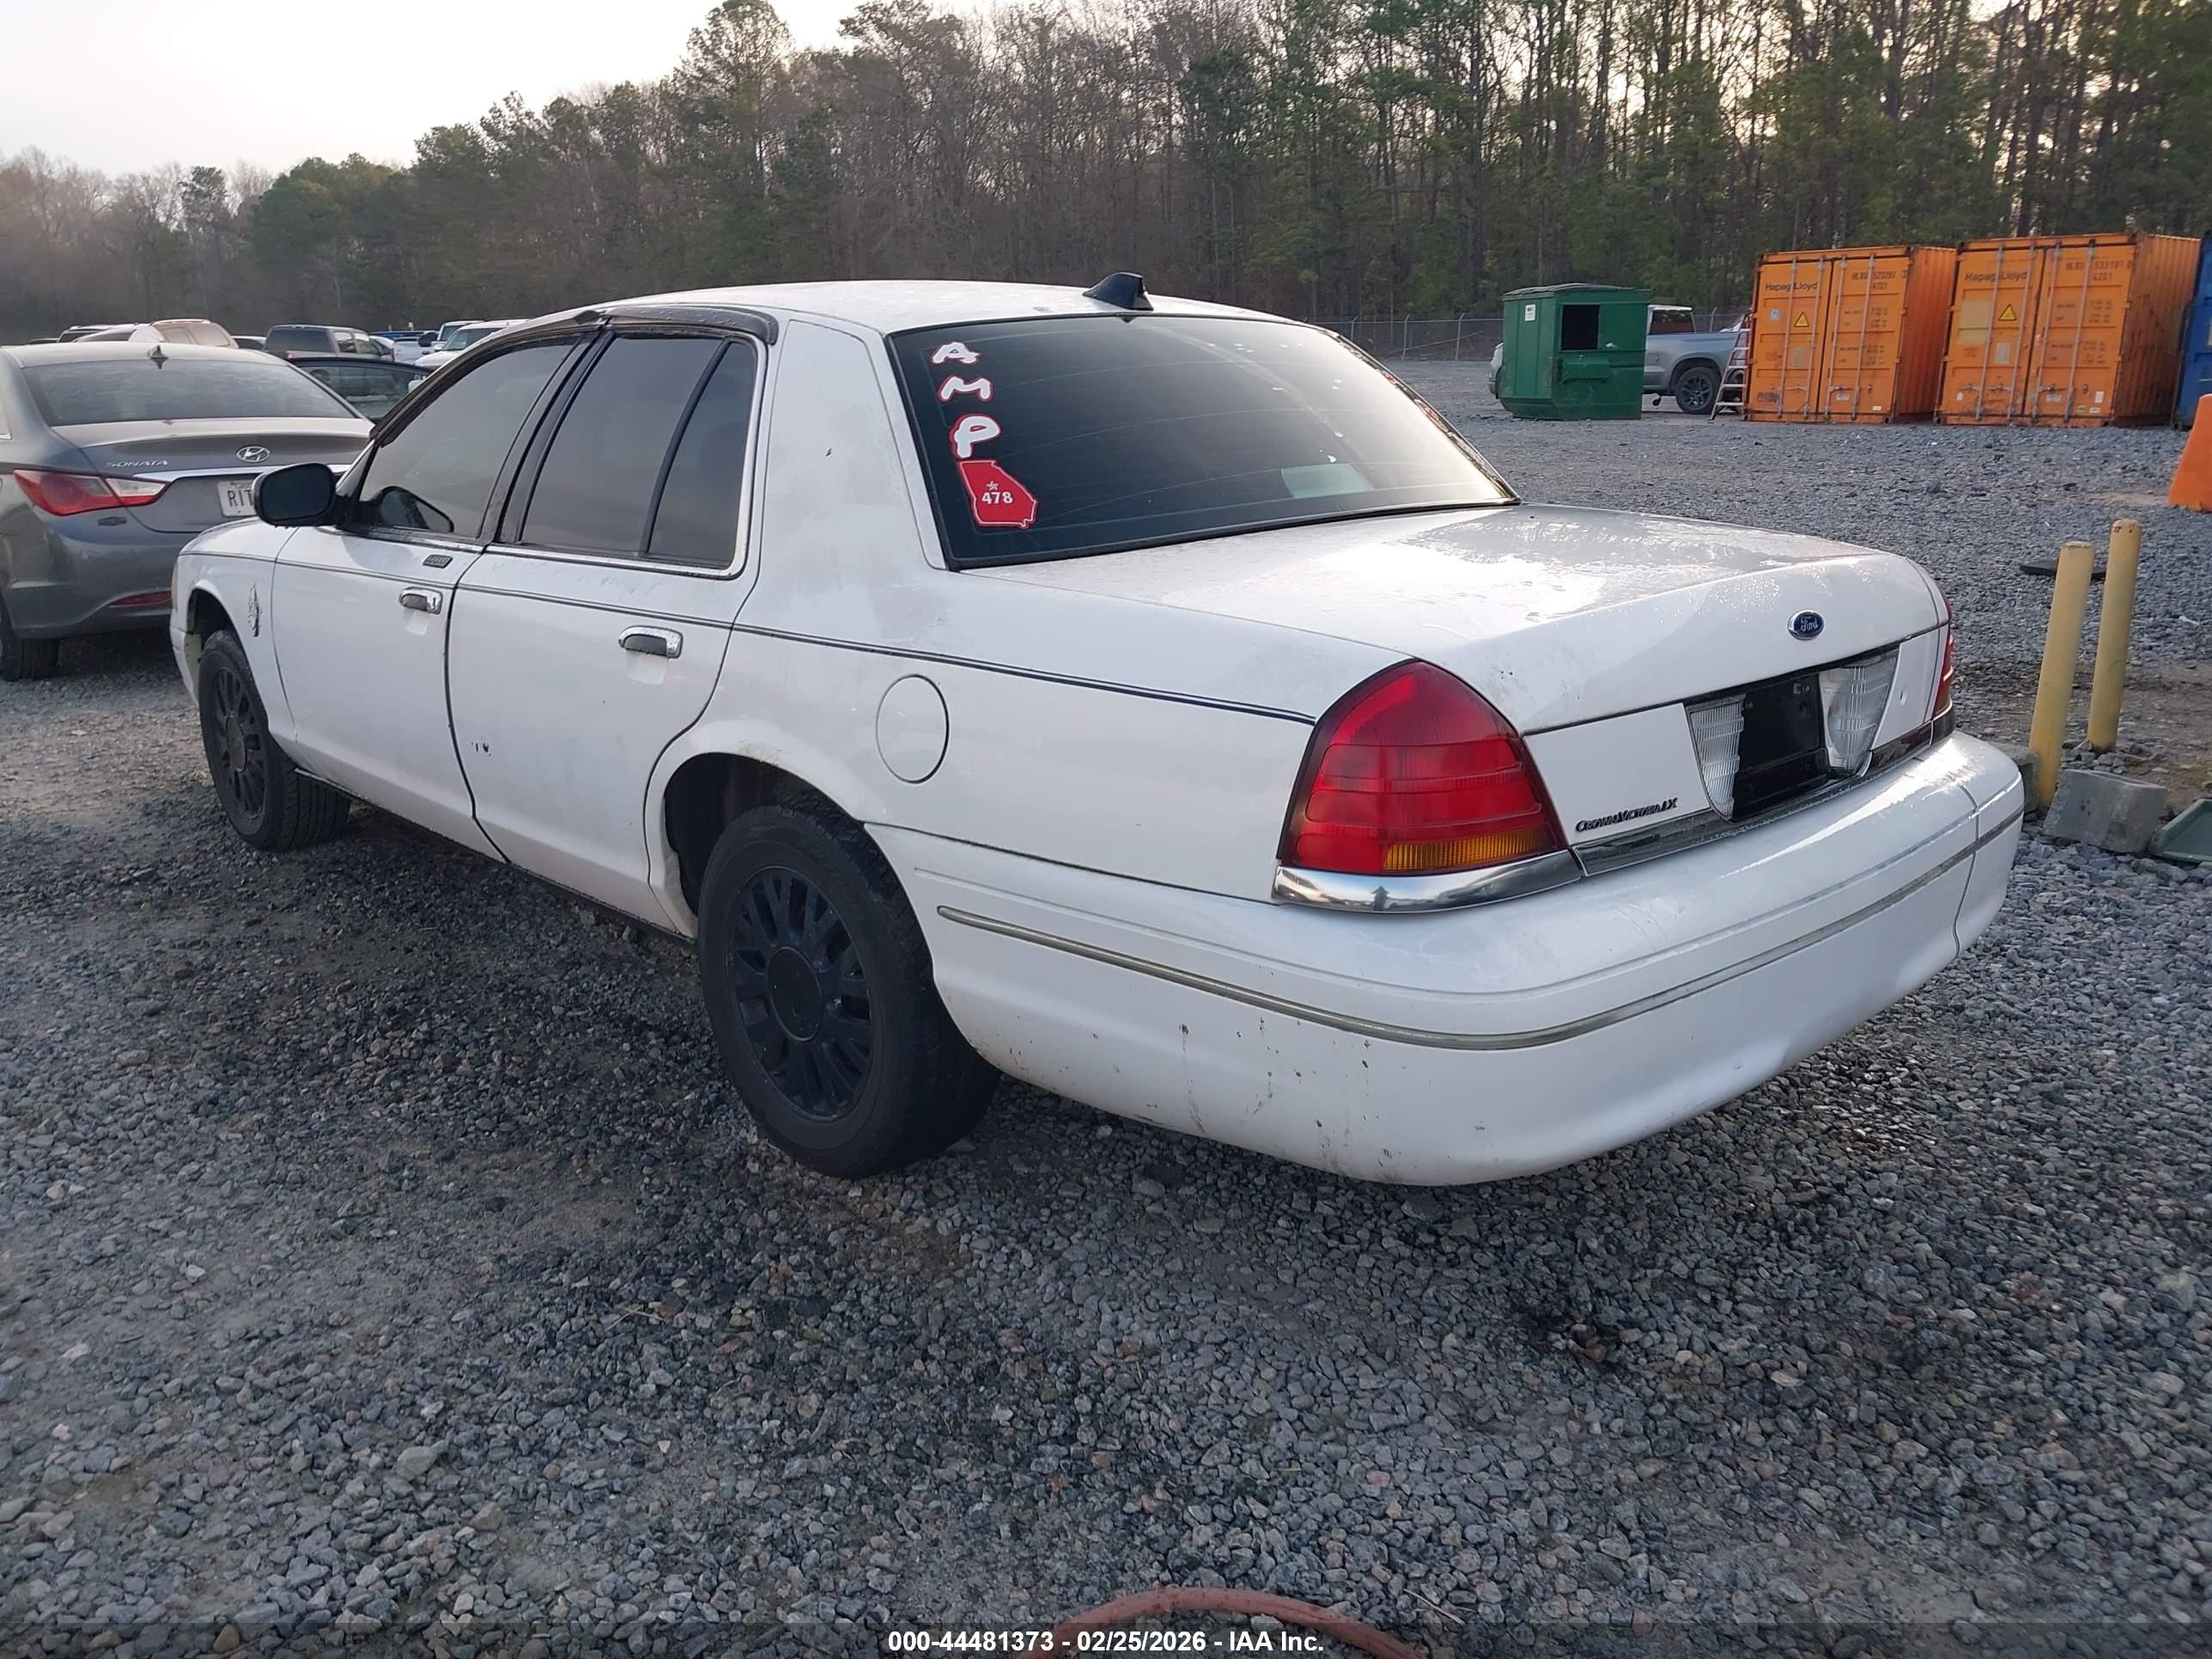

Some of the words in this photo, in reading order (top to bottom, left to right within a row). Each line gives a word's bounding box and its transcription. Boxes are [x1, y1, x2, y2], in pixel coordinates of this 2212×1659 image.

[1966, 271, 2027, 283] HapagLloyd
[1765, 281, 1818, 292] HapagLloyd
[106, 459, 168, 468] SONATA
[981, 491, 1013, 505] 478
[1800, 616, 1820, 632] Ford
